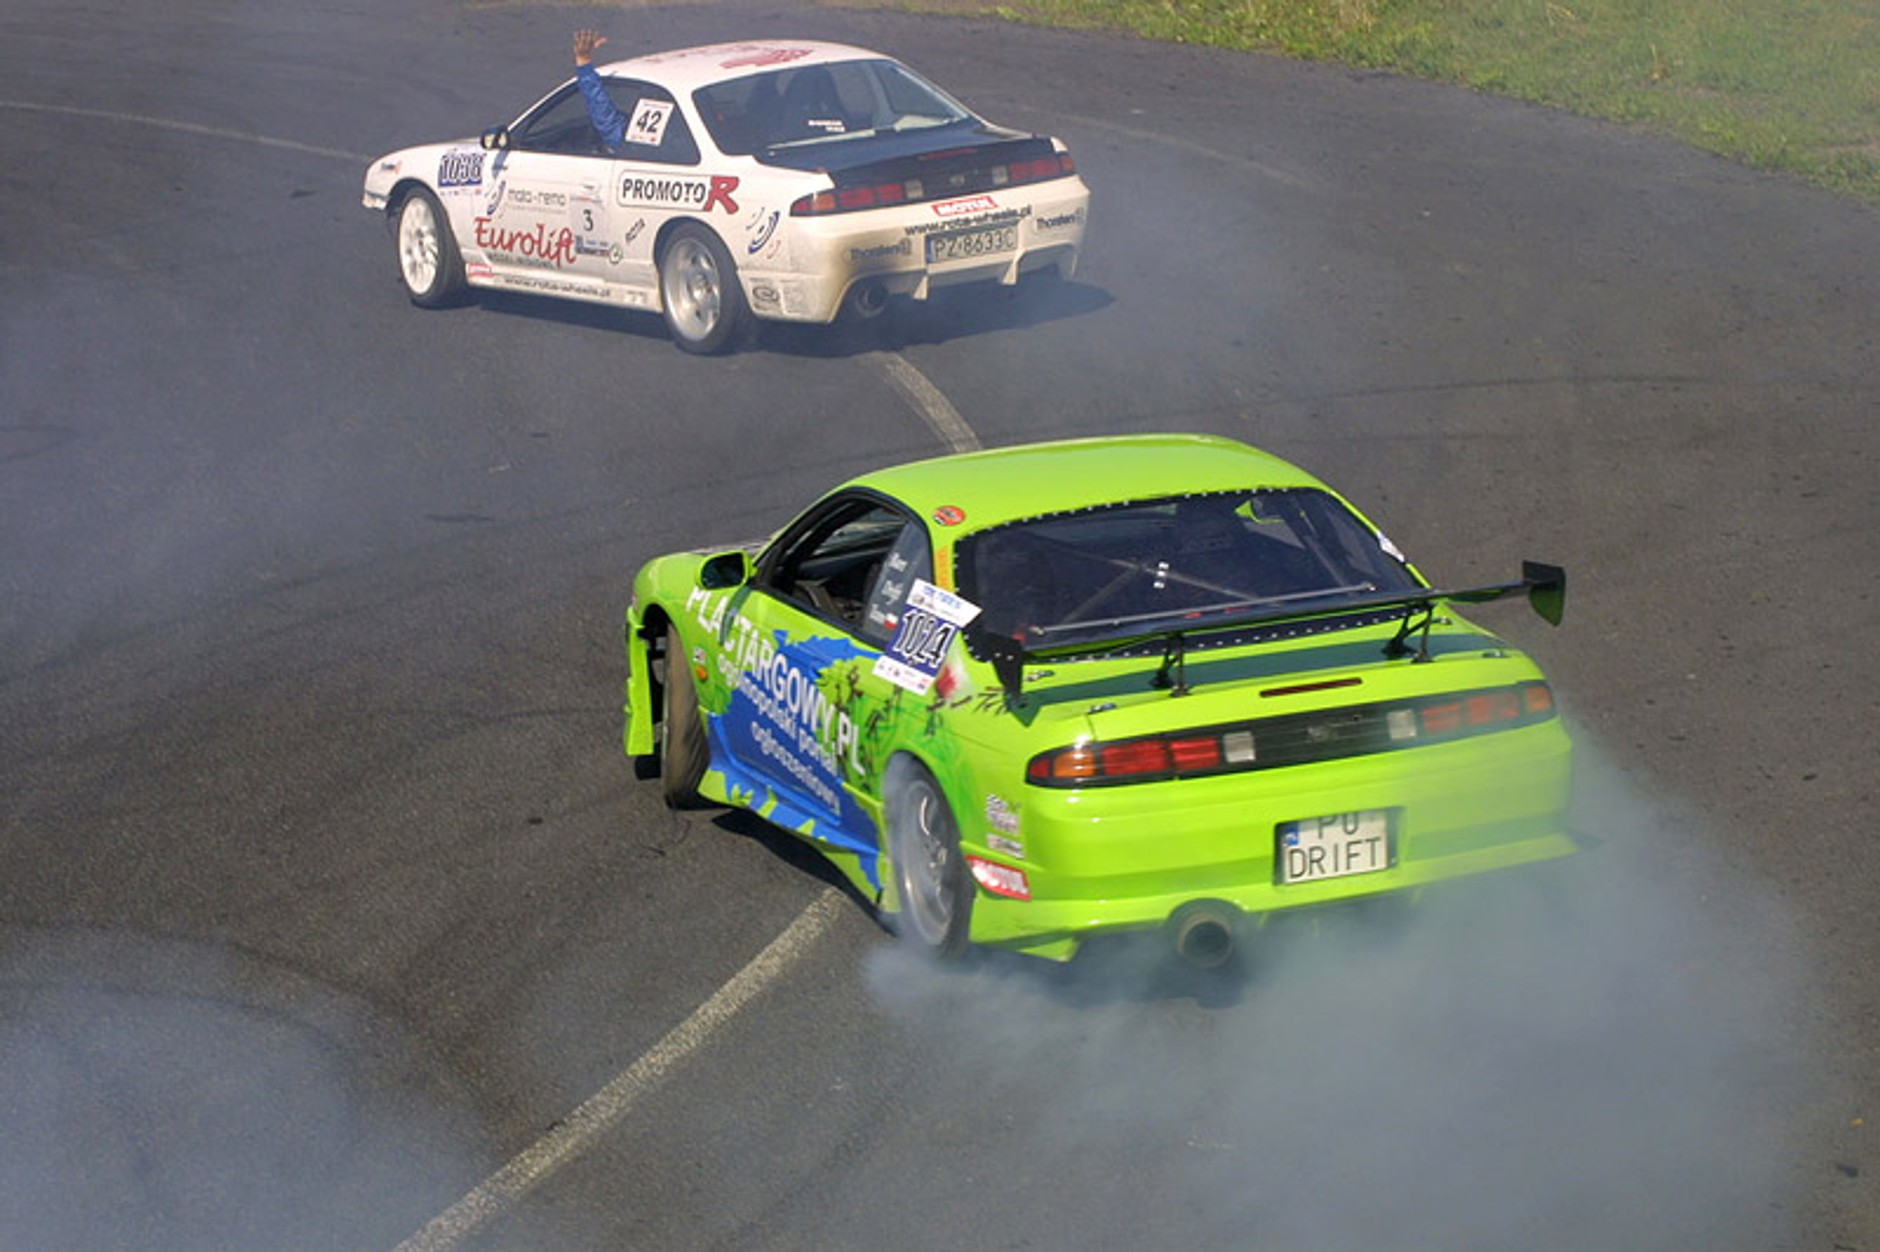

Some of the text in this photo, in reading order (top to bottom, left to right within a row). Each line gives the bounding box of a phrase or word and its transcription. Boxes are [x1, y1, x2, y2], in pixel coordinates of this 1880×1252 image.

[636, 110, 662, 133] 42
[583, 209, 594, 232] 3
[473, 216, 577, 269] Eurolift
[892, 610, 954, 668] 1024
[1288, 836, 1381, 879] DRIFT
